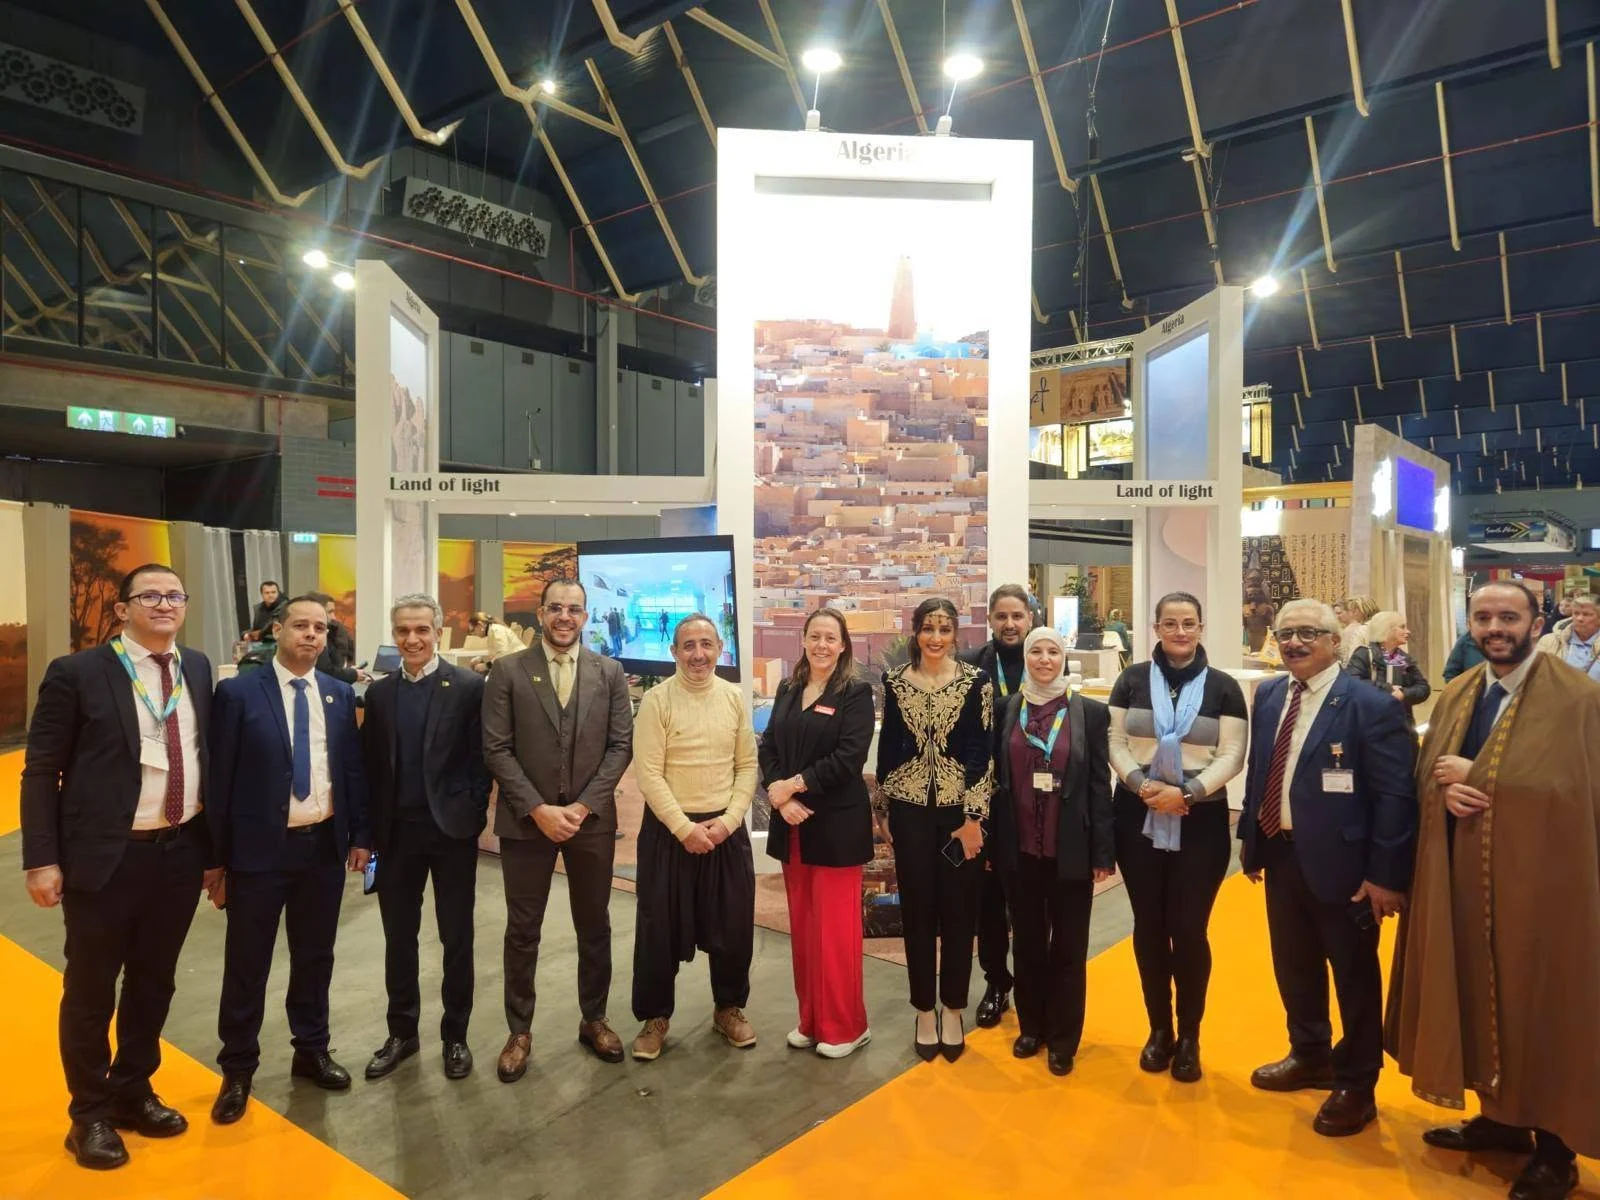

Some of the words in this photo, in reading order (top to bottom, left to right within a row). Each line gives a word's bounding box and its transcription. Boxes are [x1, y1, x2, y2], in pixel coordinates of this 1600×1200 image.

[1161, 314, 1185, 334] Algeria
[390, 477, 432, 491] Land
[438, 477, 456, 491] of
[462, 478, 501, 495] light
[1116, 484, 1153, 498] Land
[1158, 484, 1174, 498] of
[1179, 484, 1213, 501] light
